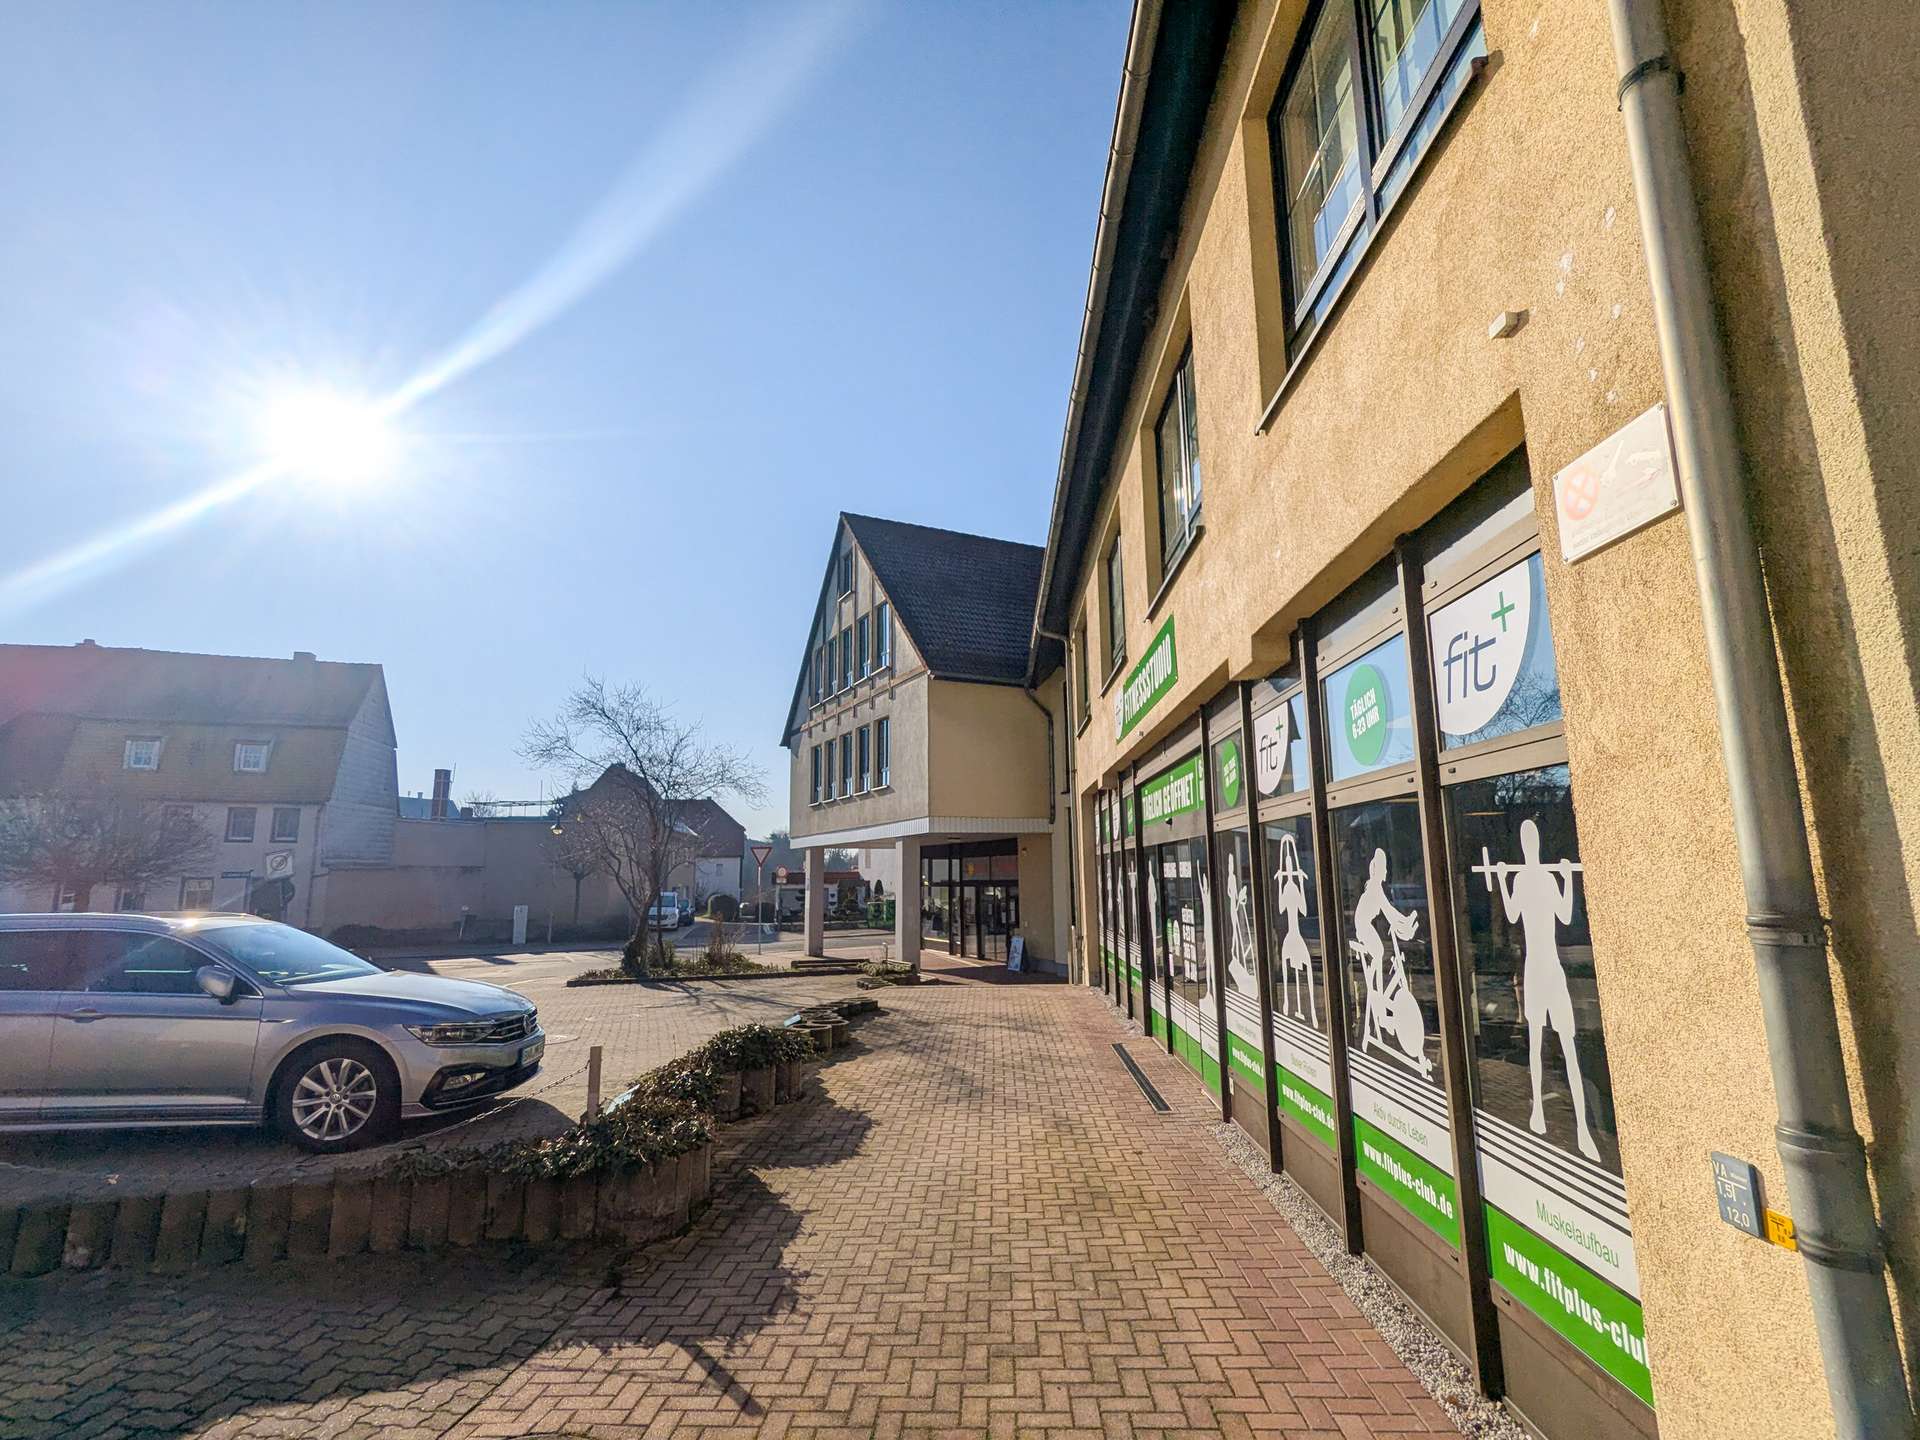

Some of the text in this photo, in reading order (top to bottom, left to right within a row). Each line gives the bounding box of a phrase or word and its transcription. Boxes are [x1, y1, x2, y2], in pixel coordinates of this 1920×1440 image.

[1124, 633, 1172, 725] FITNESSSTUDIO
[1350, 687, 1376, 721] TÄGLICH
[1352, 705, 1380, 739] 6-23 UHR
[1363, 1140, 1453, 1219] www.fitplus-club.de
[1536, 1200, 1619, 1269] Muskelaufbau
